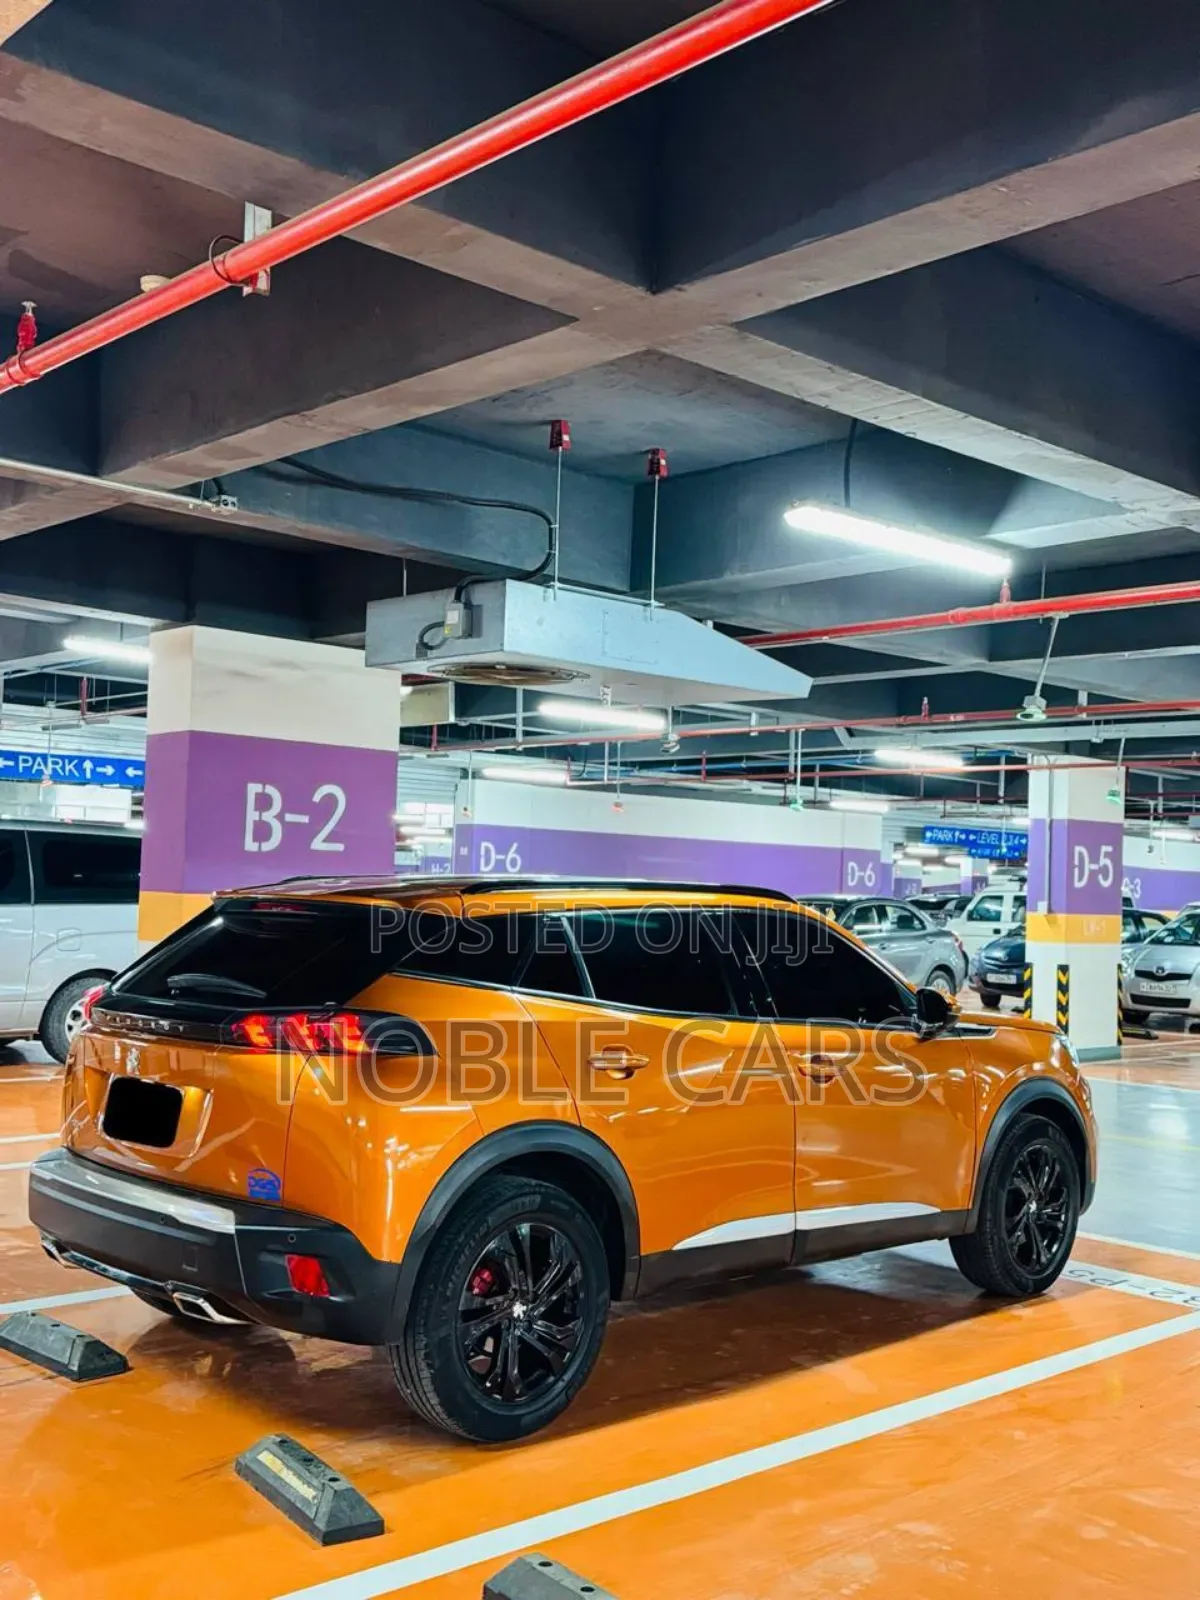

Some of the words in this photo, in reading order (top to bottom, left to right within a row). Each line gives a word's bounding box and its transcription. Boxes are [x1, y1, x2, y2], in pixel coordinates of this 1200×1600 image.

[18, 755, 80, 777] PARK
[244, 782, 347, 852] B-2
[932, 829, 954, 842] PARK
[480, 841, 522, 873] D-6
[1073, 845, 1114, 889] D-5
[847, 861, 876, 888] D-6
